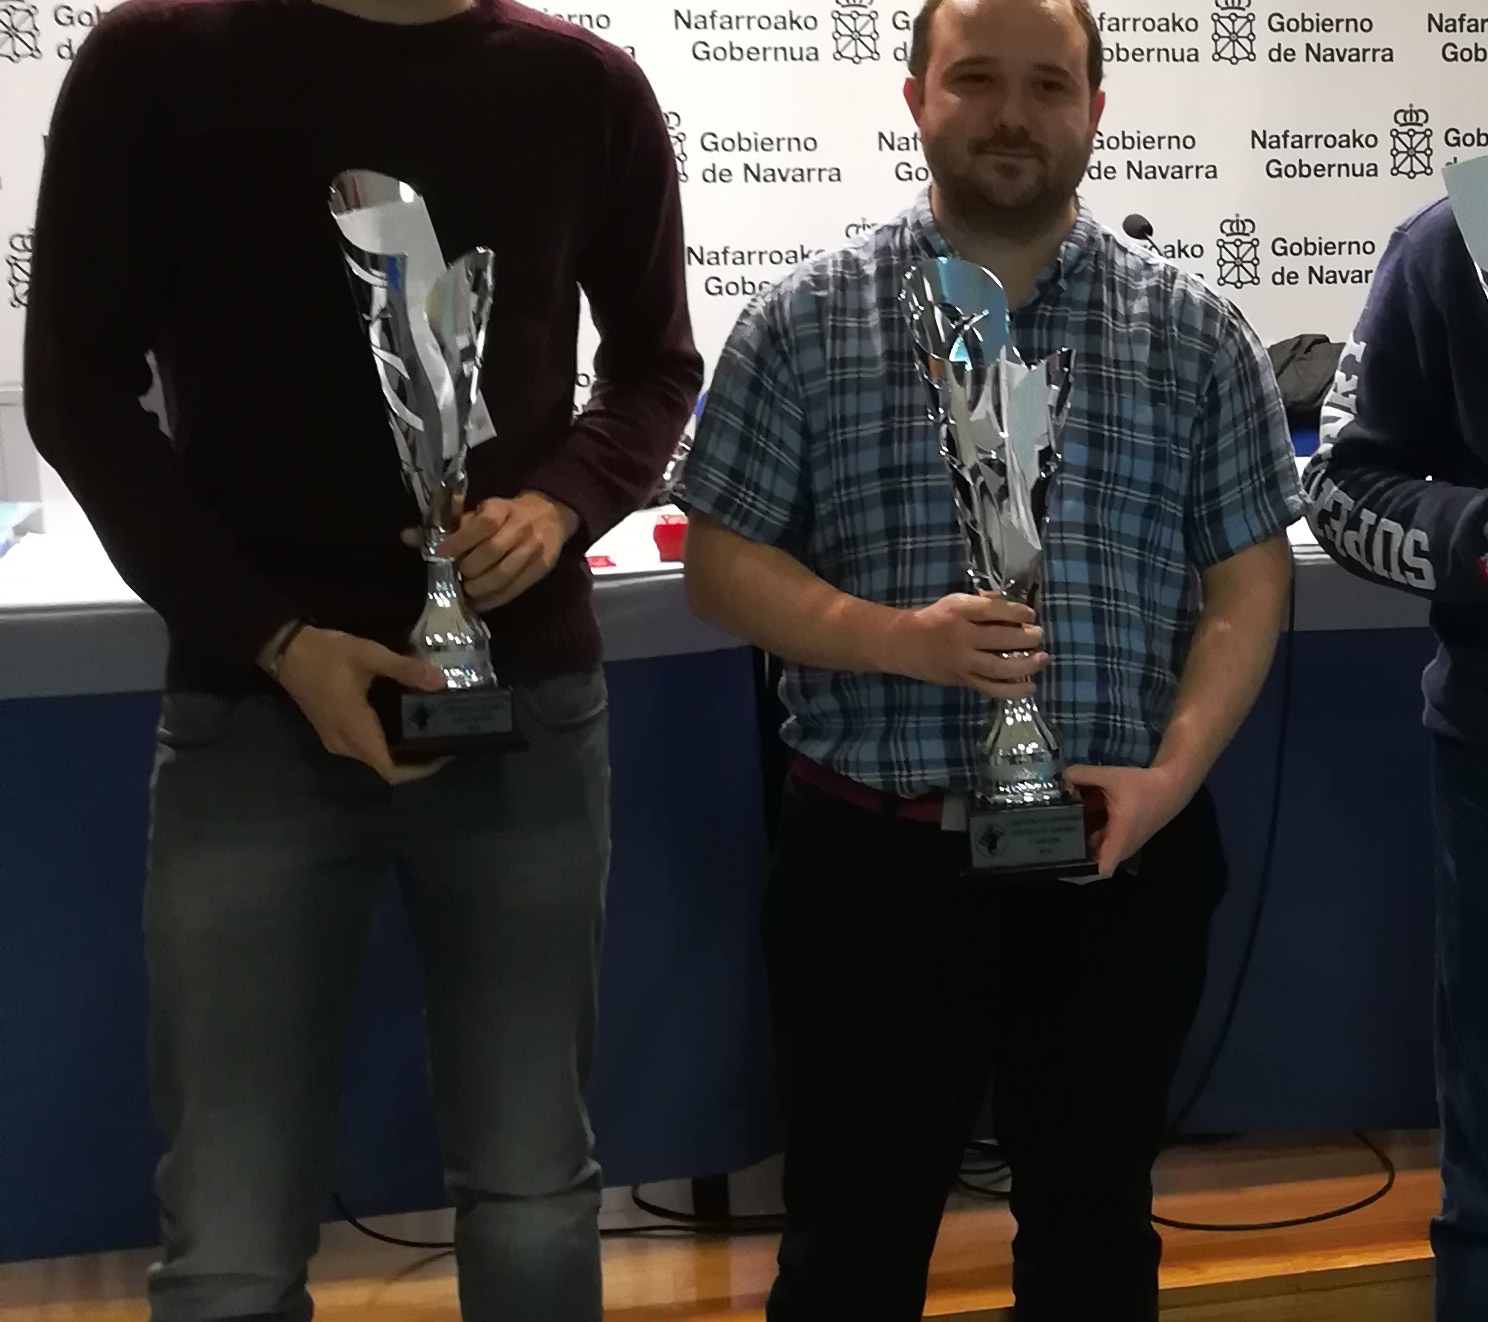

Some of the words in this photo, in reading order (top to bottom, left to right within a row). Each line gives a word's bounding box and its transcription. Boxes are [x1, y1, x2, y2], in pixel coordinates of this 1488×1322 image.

[673, 8, 819, 32] Nafarroako
[1097, 11, 1200, 34] farroako
[1267, 11, 1374, 34] Gobierno
[691, 39, 820, 63] Gobernua
[1101, 41, 1200, 63] obernua
[1267, 42, 1297, 63] de
[1304, 42, 1395, 63] Navarra
[699, 131, 819, 153] Gobierno
[1250, 128, 1379, 150] Nafarroako
[701, 162, 734, 184] de
[742, 162, 842, 184] Navarra
[1087, 160, 1117, 180] de
[1126, 159, 1218, 181] Navarra
[1265, 158, 1379, 179] Gobernua
[686, 243, 826, 266] Nafarroak
[1270, 236, 1376, 257] Gobierno
[1271, 265, 1300, 287] de
[1307, 264, 1374, 285] Navar
